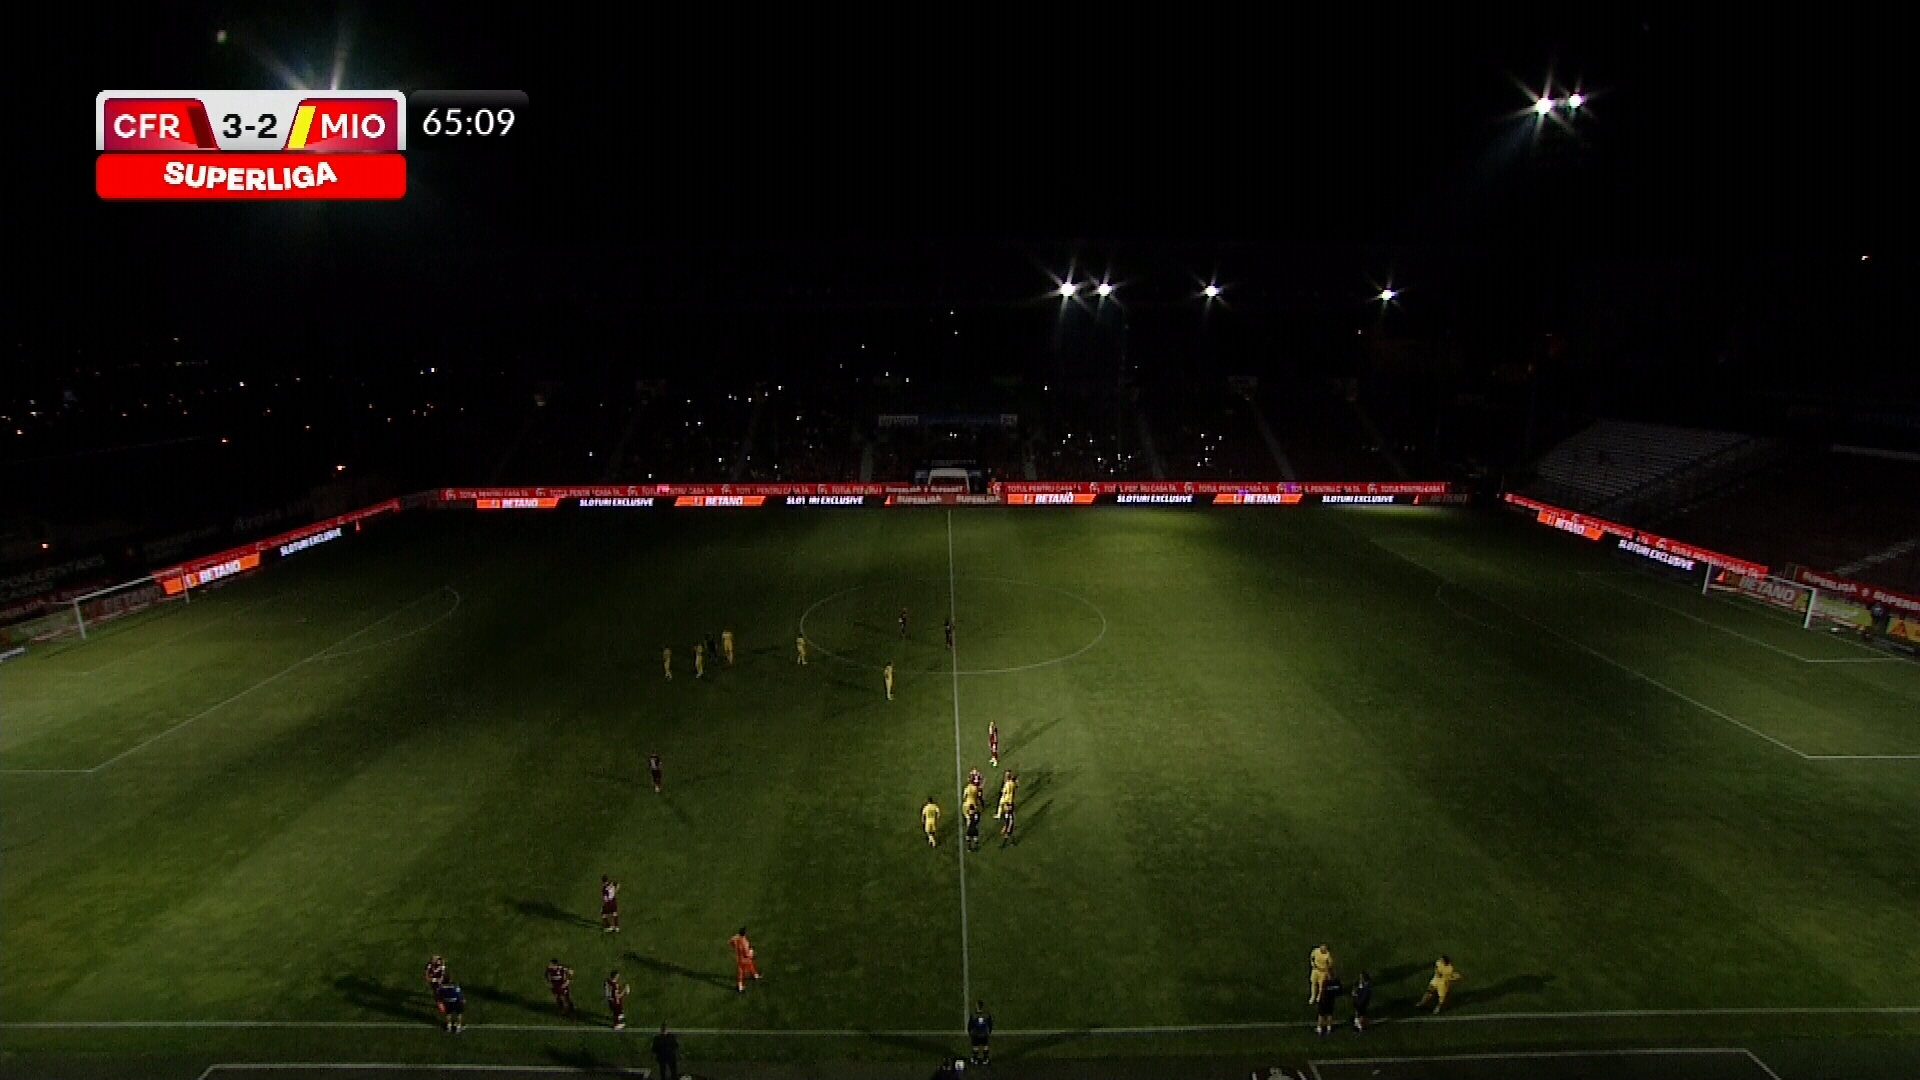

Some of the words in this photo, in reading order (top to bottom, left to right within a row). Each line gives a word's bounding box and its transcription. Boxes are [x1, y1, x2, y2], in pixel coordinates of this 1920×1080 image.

[502, 498, 538, 508] BETANO
[580, 498, 611, 507] SLOTURI
[612, 498, 654, 507] EXCLUSIVE
[705, 497, 744, 507] BETANO
[820, 496, 864, 504] EXCLUSIVE
[1034, 494, 1074, 503] BETANO
[1117, 495, 1150, 503] SLOTURI
[1150, 495, 1193, 503] EXCLUSIVE
[1243, 494, 1281, 503] BETANO
[1322, 495, 1354, 503] SLOTURI
[1354, 495, 1394, 503] EXCLUSIVE
[1555, 517, 1585, 535] BETANO
[1618, 539, 1650, 557] SLOTURI
[1649, 549, 1695, 571] EXCLUSIVE
[199, 559, 241, 584] BETANO
[1803, 571, 1857, 593] SUPERLIGA
[1739, 575, 1796, 601] BETANO
